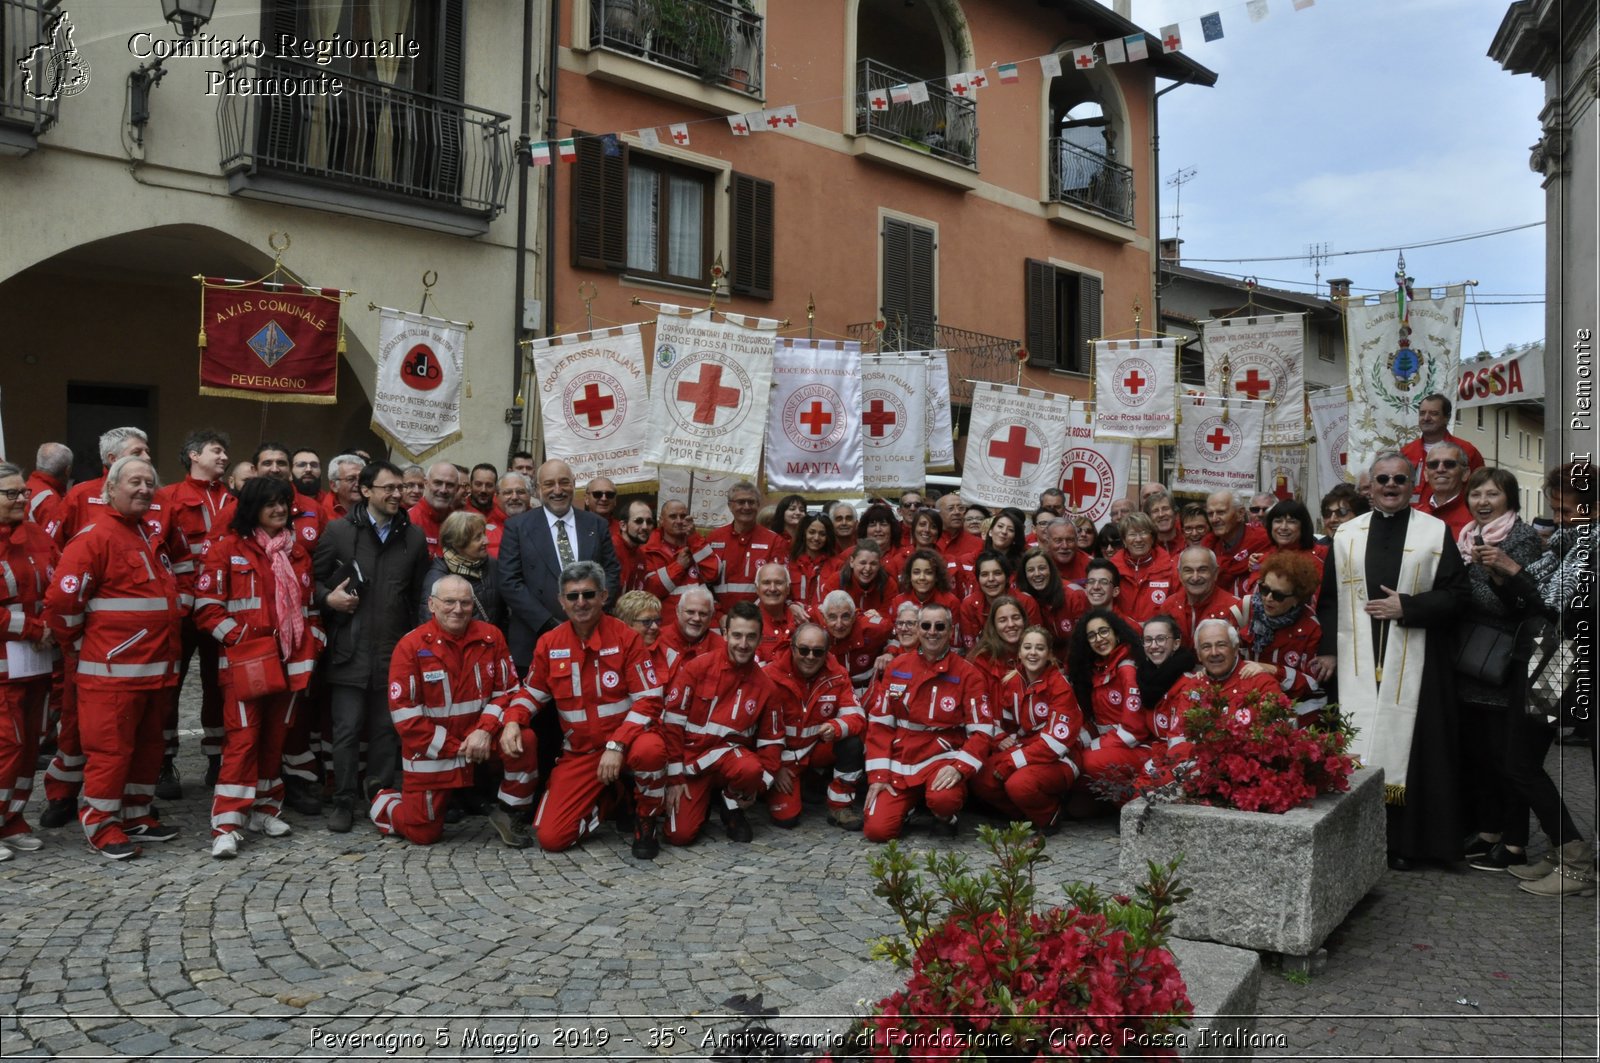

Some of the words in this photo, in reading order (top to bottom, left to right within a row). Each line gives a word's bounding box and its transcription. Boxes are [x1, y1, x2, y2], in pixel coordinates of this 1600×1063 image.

[217, 301, 256, 323] A.V.I.S.
[259, 300, 327, 331] COMUNALE
[1365, 312, 1396, 329] COMUNE
[1409, 309, 1449, 324] EVERAGNO
[663, 324, 684, 333] CORPO
[686, 327, 720, 338] VOLONTARI
[723, 332, 734, 340] DEL
[738, 335, 770, 345] SOCCORSO
[658, 333, 691, 345] CROCE
[694, 340, 727, 349] ROSSA
[731, 343, 774, 355] ITALIANA
[1229, 341, 1264, 355] ROSSA
[544, 360, 568, 393] CROCE
[566, 348, 600, 365] ROSSA
[603, 349, 641, 379] ITALIANA
[670, 352, 717, 380] CONVENZIONE
[729, 360, 751, 390] GINEVRA
[824, 369, 856, 377] ITALIANA
[231, 374, 306, 389] PEVERAGNO
[862, 372, 886, 380] ROSSA
[888, 374, 916, 396] ITALIANA
[1459, 359, 1524, 400] OSSA
[378, 392, 406, 404] GRUPPO
[795, 391, 804, 402] DI
[803, 386, 835, 401] GINEVRA
[376, 403, 401, 415] BOVES
[563, 386, 581, 433] CONVENZIONE
[572, 380, 579, 389] DI
[578, 373, 606, 383] GINEVRA
[606, 377, 615, 386] 22
[613, 383, 625, 413] AGOSTO
[974, 403, 1003, 412] CROCE
[1004, 407, 1030, 417] ROSSA
[1032, 411, 1066, 422] ITALIANA
[1098, 413, 1119, 421] Croce
[1121, 413, 1142, 421] Rossa
[1143, 413, 1171, 421] Italiana
[396, 420, 440, 433] PEVERAGNO
[1072, 427, 1091, 438] ROSSA
[664, 436, 701, 448] COMITATO
[563, 452, 605, 464] COMITATO
[606, 448, 639, 460] LOCALE
[669, 447, 732, 465] MORETTA
[597, 465, 640, 478] PIEMONTE
[786, 462, 841, 475] MANTA
[1202, 468, 1225, 478] Rossa
[1227, 471, 1255, 480] Italiana
[863, 475, 900, 483] RONERO
[1088, 454, 1097, 463] DI
[1097, 462, 1112, 499] GINEVRA
[977, 484, 1031, 499] DELEGAZIONE
[978, 492, 1038, 508] PEVERAGNO
[692, 512, 728, 522] USCA
